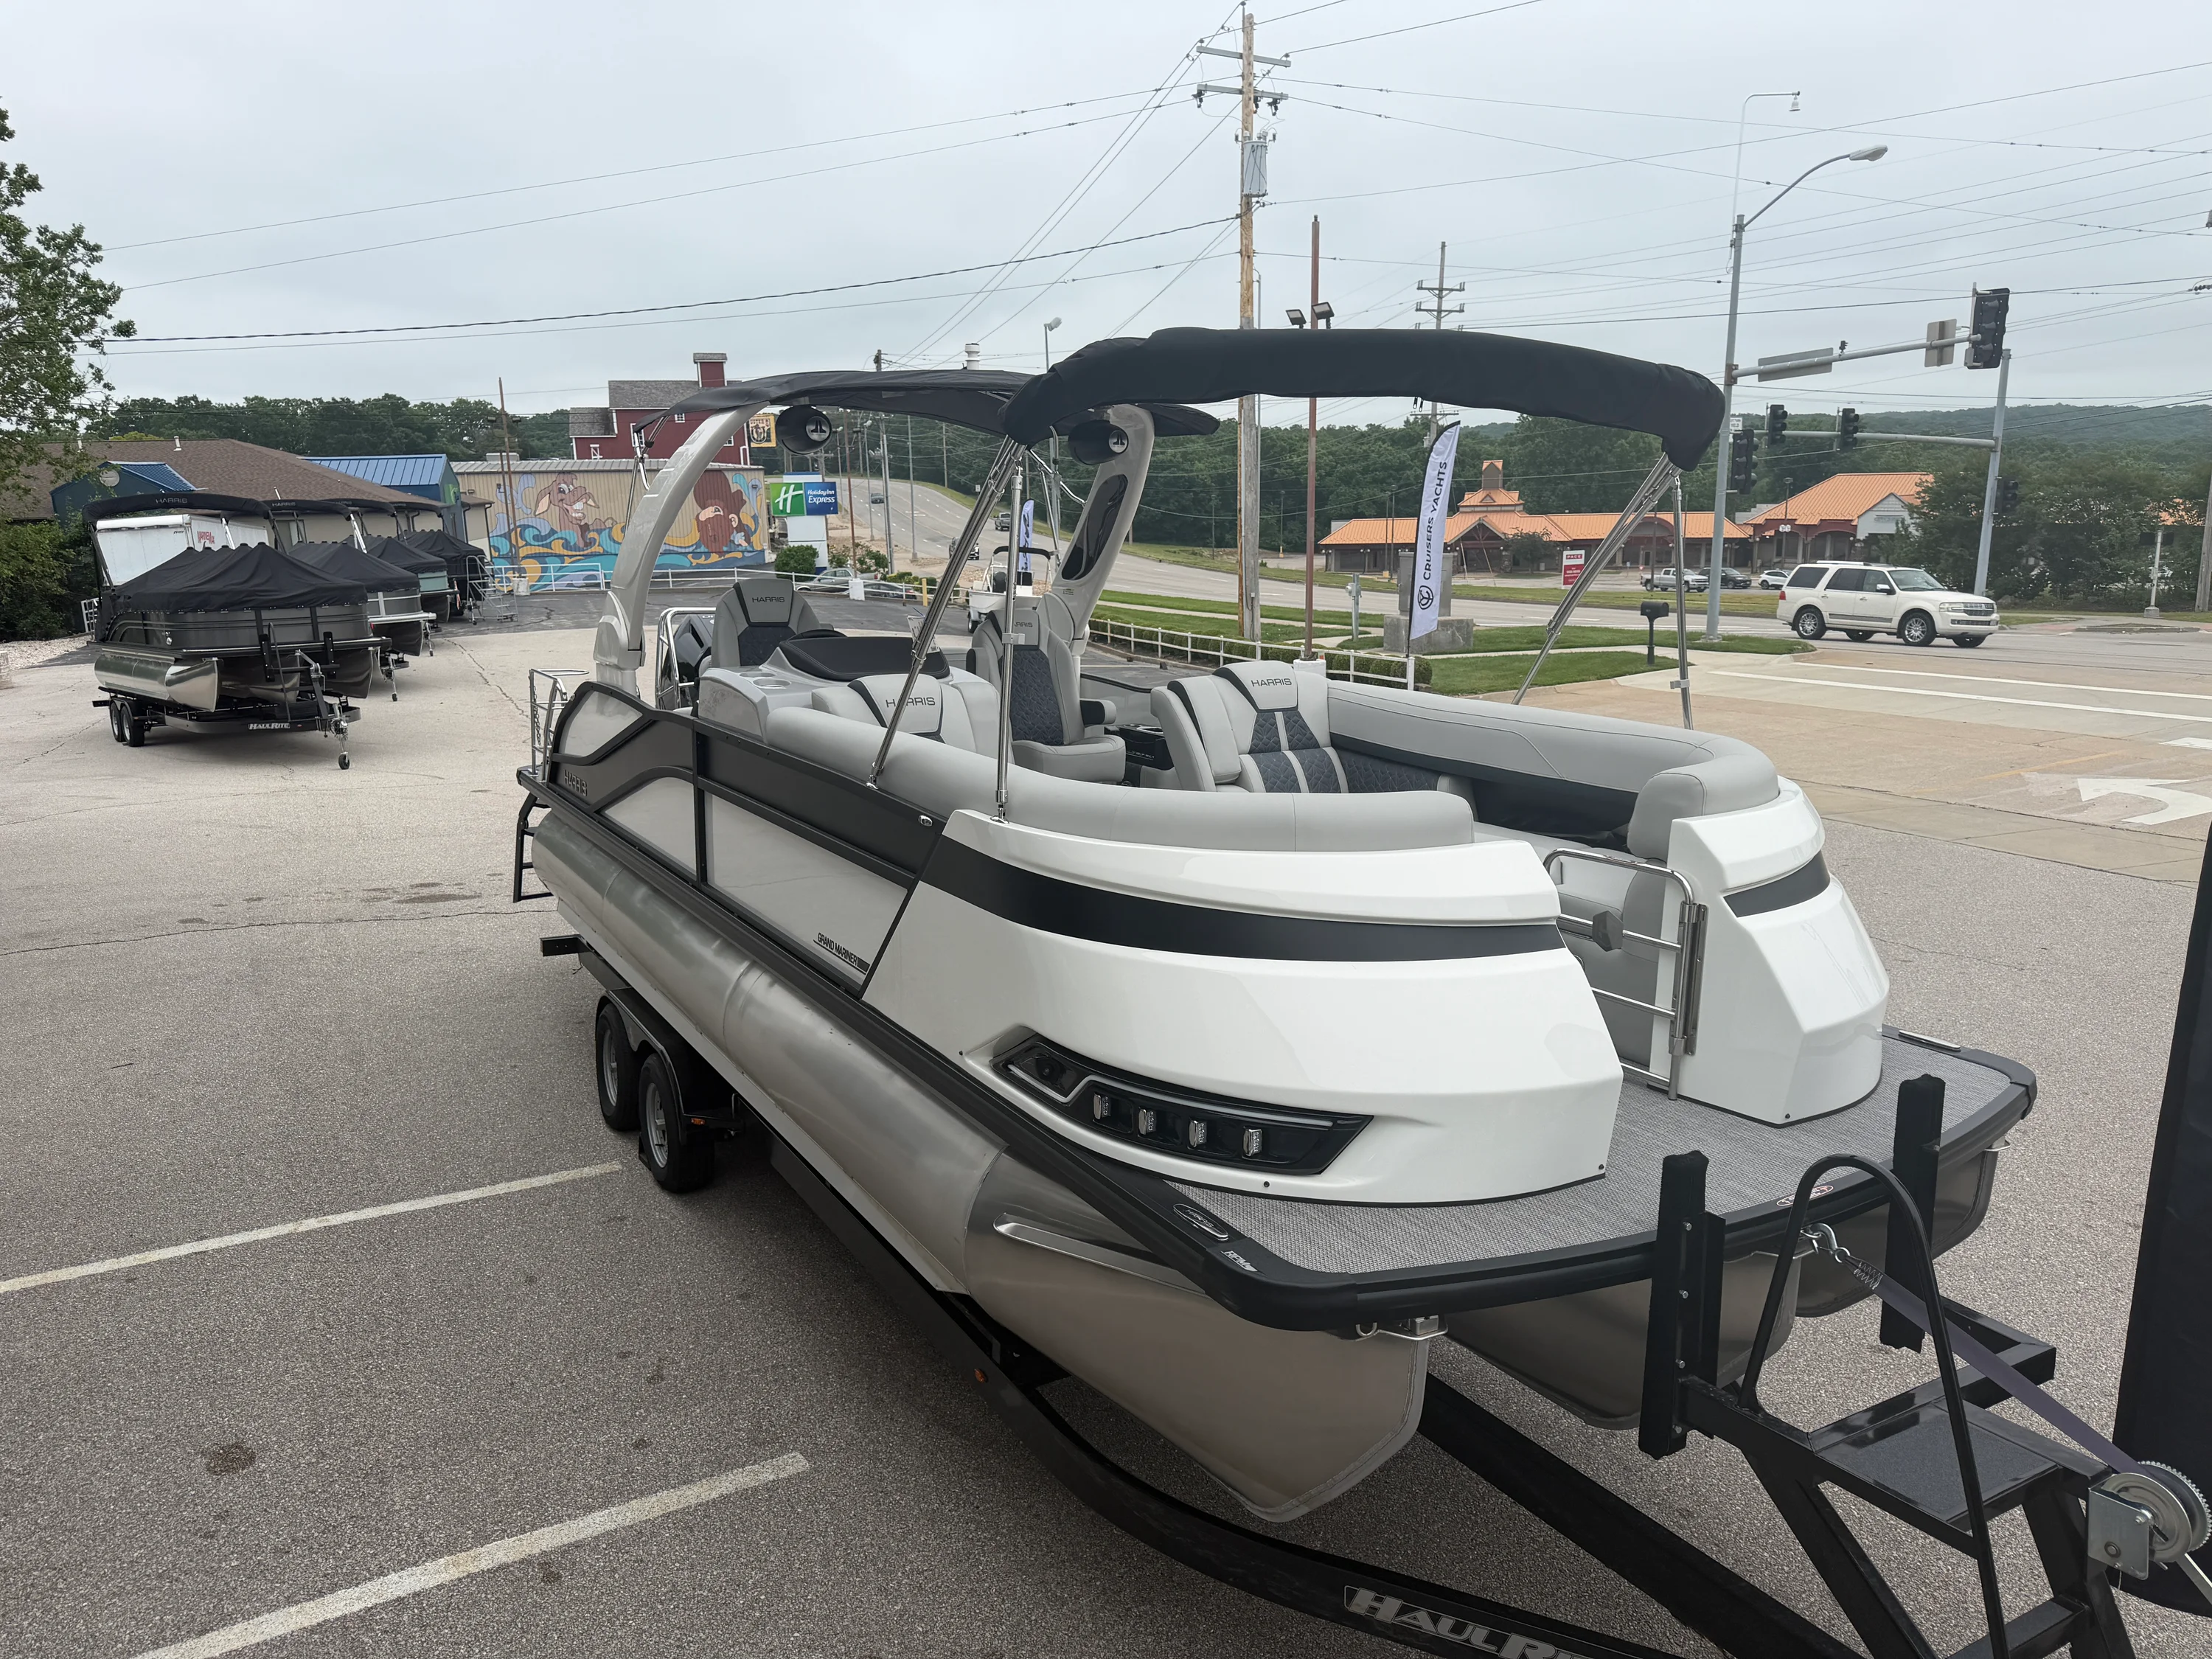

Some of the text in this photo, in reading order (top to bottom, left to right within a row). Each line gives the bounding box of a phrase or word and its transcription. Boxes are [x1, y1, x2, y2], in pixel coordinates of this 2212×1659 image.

[808, 496, 835, 504] Express
[1423, 462, 1447, 580] CRUISERS YACHTS
[1251, 678, 1293, 686] HARRIS
[886, 697, 936, 708] HRRIS
[564, 769, 588, 796] HARRIS
[818, 932, 858, 966] GRAND MARINER
